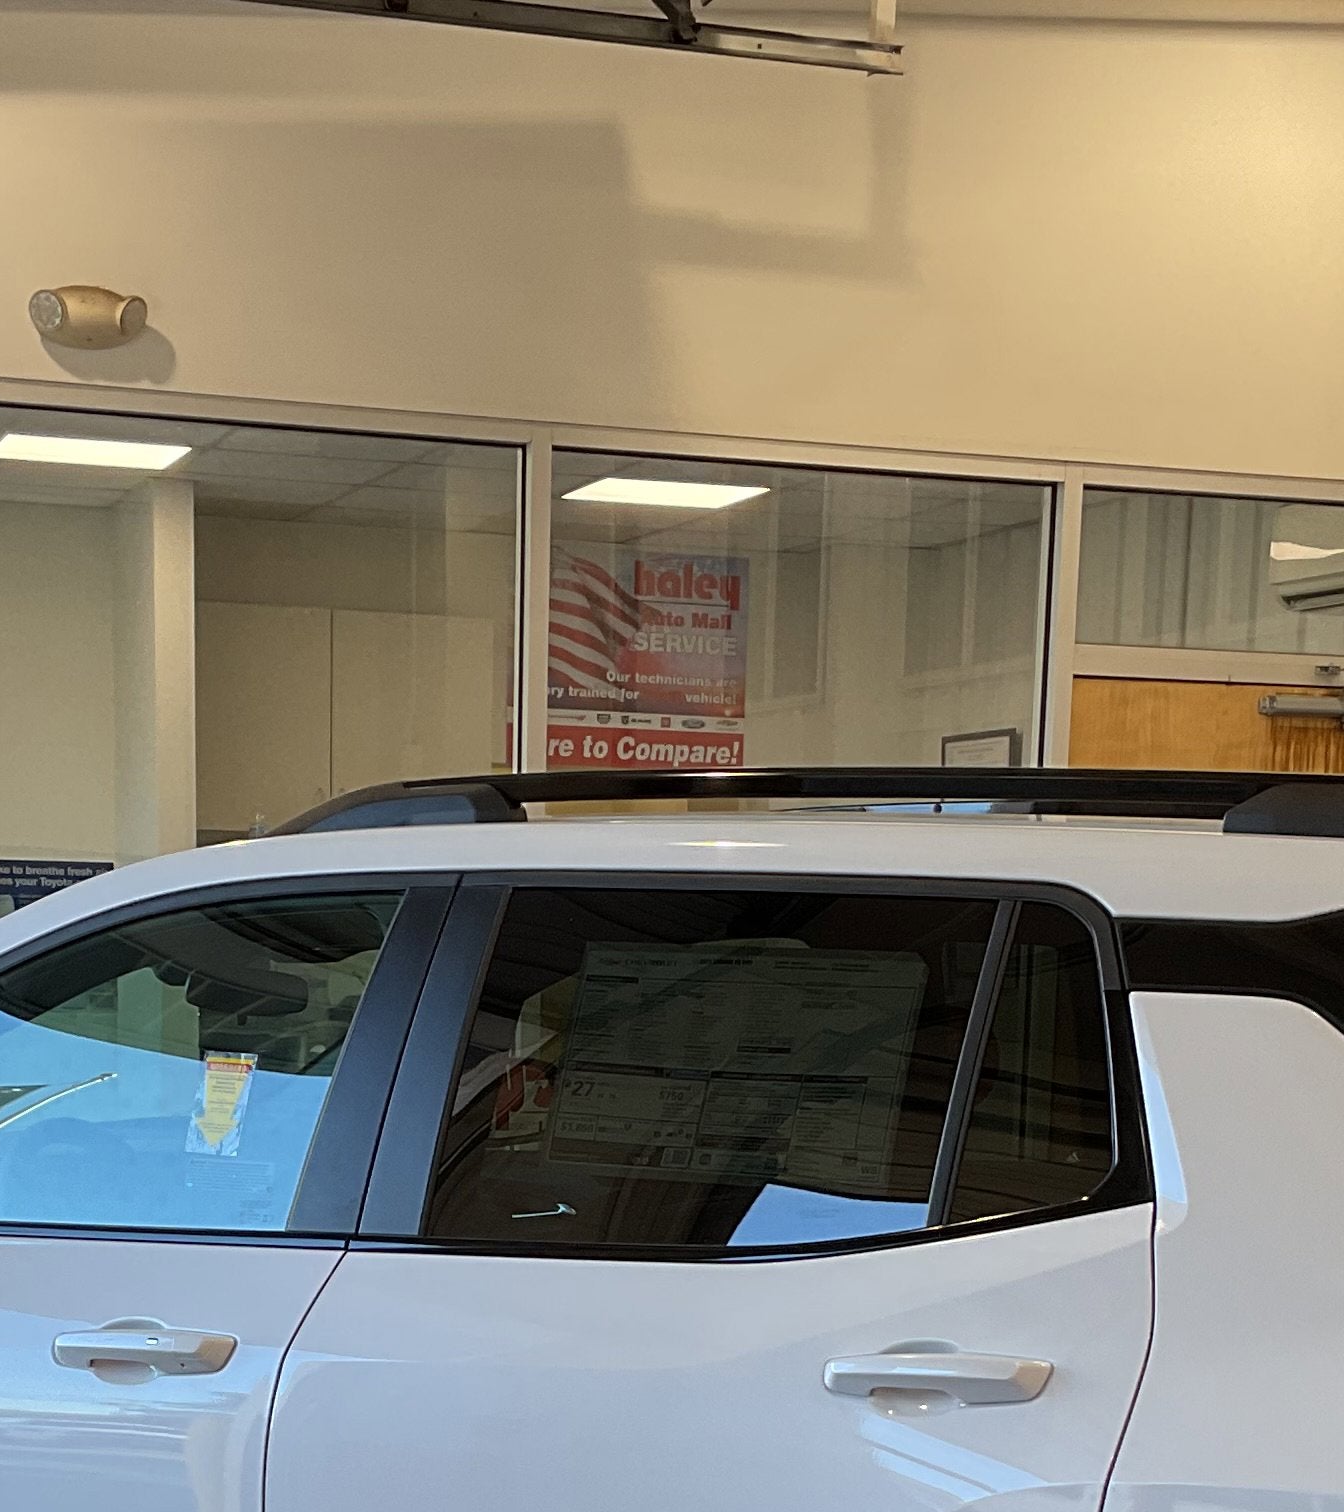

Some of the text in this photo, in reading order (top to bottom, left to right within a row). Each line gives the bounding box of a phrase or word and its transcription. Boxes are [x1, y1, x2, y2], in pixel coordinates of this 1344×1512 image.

[634, 560, 741, 611] haley
[640, 611, 732, 631] Auto Mall
[633, 631, 737, 656] SERVICE
[606, 671, 631, 684] Our
[635, 673, 712, 688] technicians
[568, 686, 616, 700] trained
[619, 688, 640, 702] for
[583, 735, 609, 759] to
[617, 736, 740, 767] Compare!
[12, 865, 23, 875] to
[25, 866, 65, 876] breathe
[67, 867, 93, 877] fresh
[15, 878, 38, 887] your
[571, 1080, 596, 1097] 27
